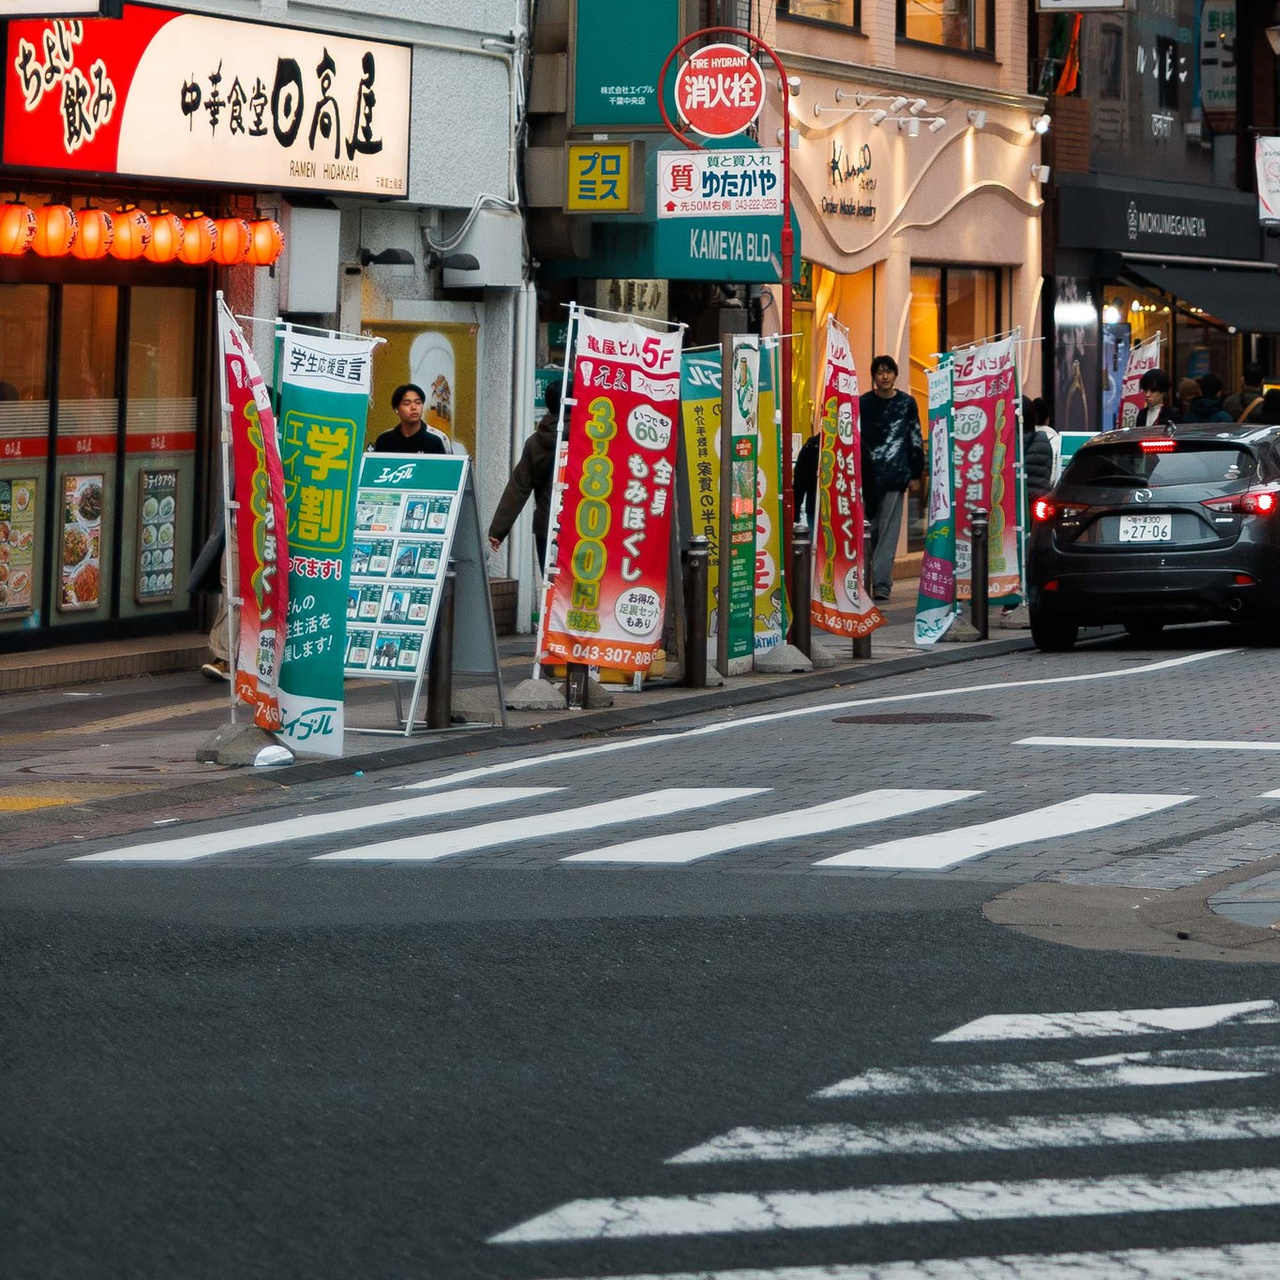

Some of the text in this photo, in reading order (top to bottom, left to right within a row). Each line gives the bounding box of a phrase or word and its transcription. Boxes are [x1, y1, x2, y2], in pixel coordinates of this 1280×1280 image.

[690, 56, 749, 70] FIRE HYDRANT
[600, 85, 655, 95] 株式会社エイブル
[684, 72, 757, 111] 消火栓
[61, 58, 117, 154] 飲み
[180, 46, 383, 161] 中華食堂 日高屋
[289, 160, 360, 183] RAMEN HIDAKAYA
[578, 152, 621, 177] プロ
[706, 154, 773, 168] 質と買入れ
[578, 179, 620, 201] ミス
[670, 163, 694, 192] 質
[702, 169, 778, 198] ゆたかや
[679, 199, 732, 212] 先50M右側
[820, 195, 877, 223] Order Made Jewelry
[1138, 211, 1207, 239] MOKUMEGANEYA
[689, 228, 771, 263] KAMEYA BLD
[289, 346, 368, 383] 学生応援宣言
[587, 334, 673, 371] 亀屋ビル 5F
[594, 366, 677, 399] 元気 スペース
[633, 409, 669, 428] いつでも
[634, 422, 669, 446] 60分
[299, 424, 349, 543] 学割
[373, 463, 418, 484] エイブル
[621, 453, 649, 582] もみほぐし
[1131, 525, 1168, 539] 27-06
[627, 591, 656, 607] お得な
[624, 615, 652, 631] もあり
[549, 643, 569, 655] TEL
[277, 706, 338, 742] エイブル
